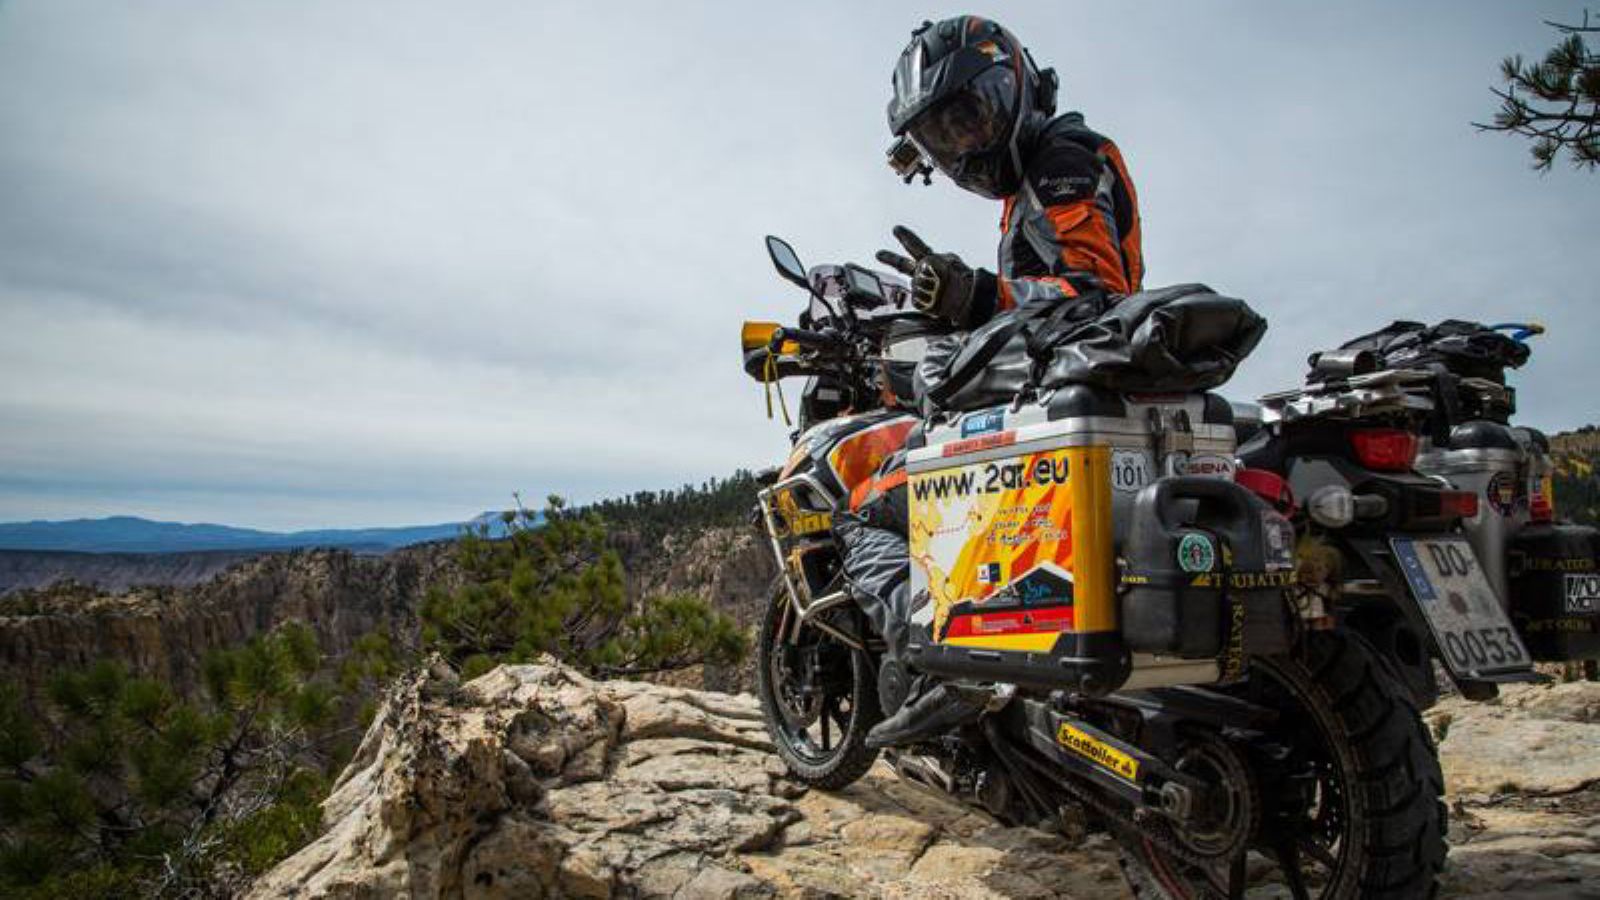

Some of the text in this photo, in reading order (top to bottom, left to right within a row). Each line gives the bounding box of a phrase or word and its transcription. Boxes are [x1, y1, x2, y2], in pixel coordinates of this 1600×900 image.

[913, 456, 1069, 501] www.2ar.eu
[1115, 465, 1143, 486] 101
[1189, 462, 1231, 475] SENA
[1444, 627, 1523, 667] 0053
